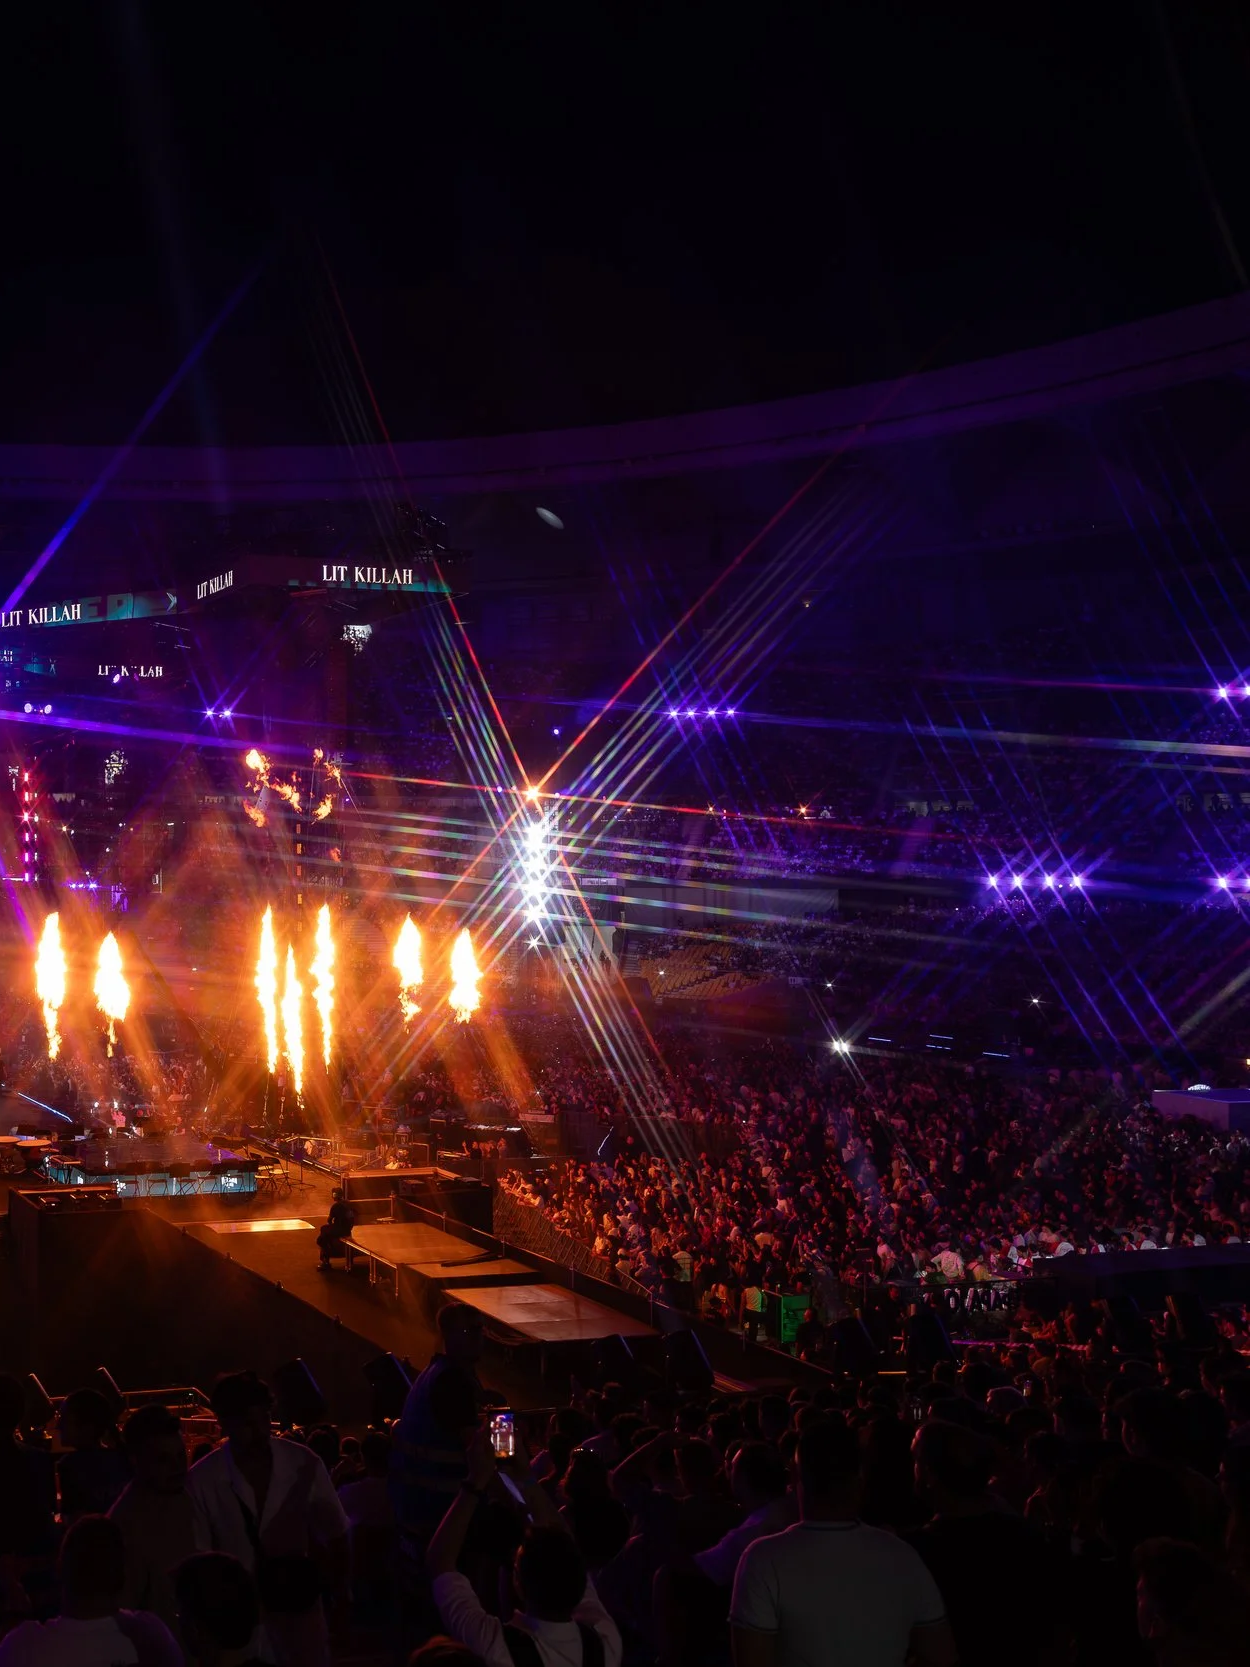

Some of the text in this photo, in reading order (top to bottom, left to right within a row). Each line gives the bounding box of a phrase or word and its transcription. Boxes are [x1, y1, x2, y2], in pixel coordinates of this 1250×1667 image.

[197, 570, 233, 599] LIT KILLAH
[322, 564, 413, 585] LIT KILLAH
[1, 611, 23, 628] LIT
[28, 603, 82, 625] KILLAH
